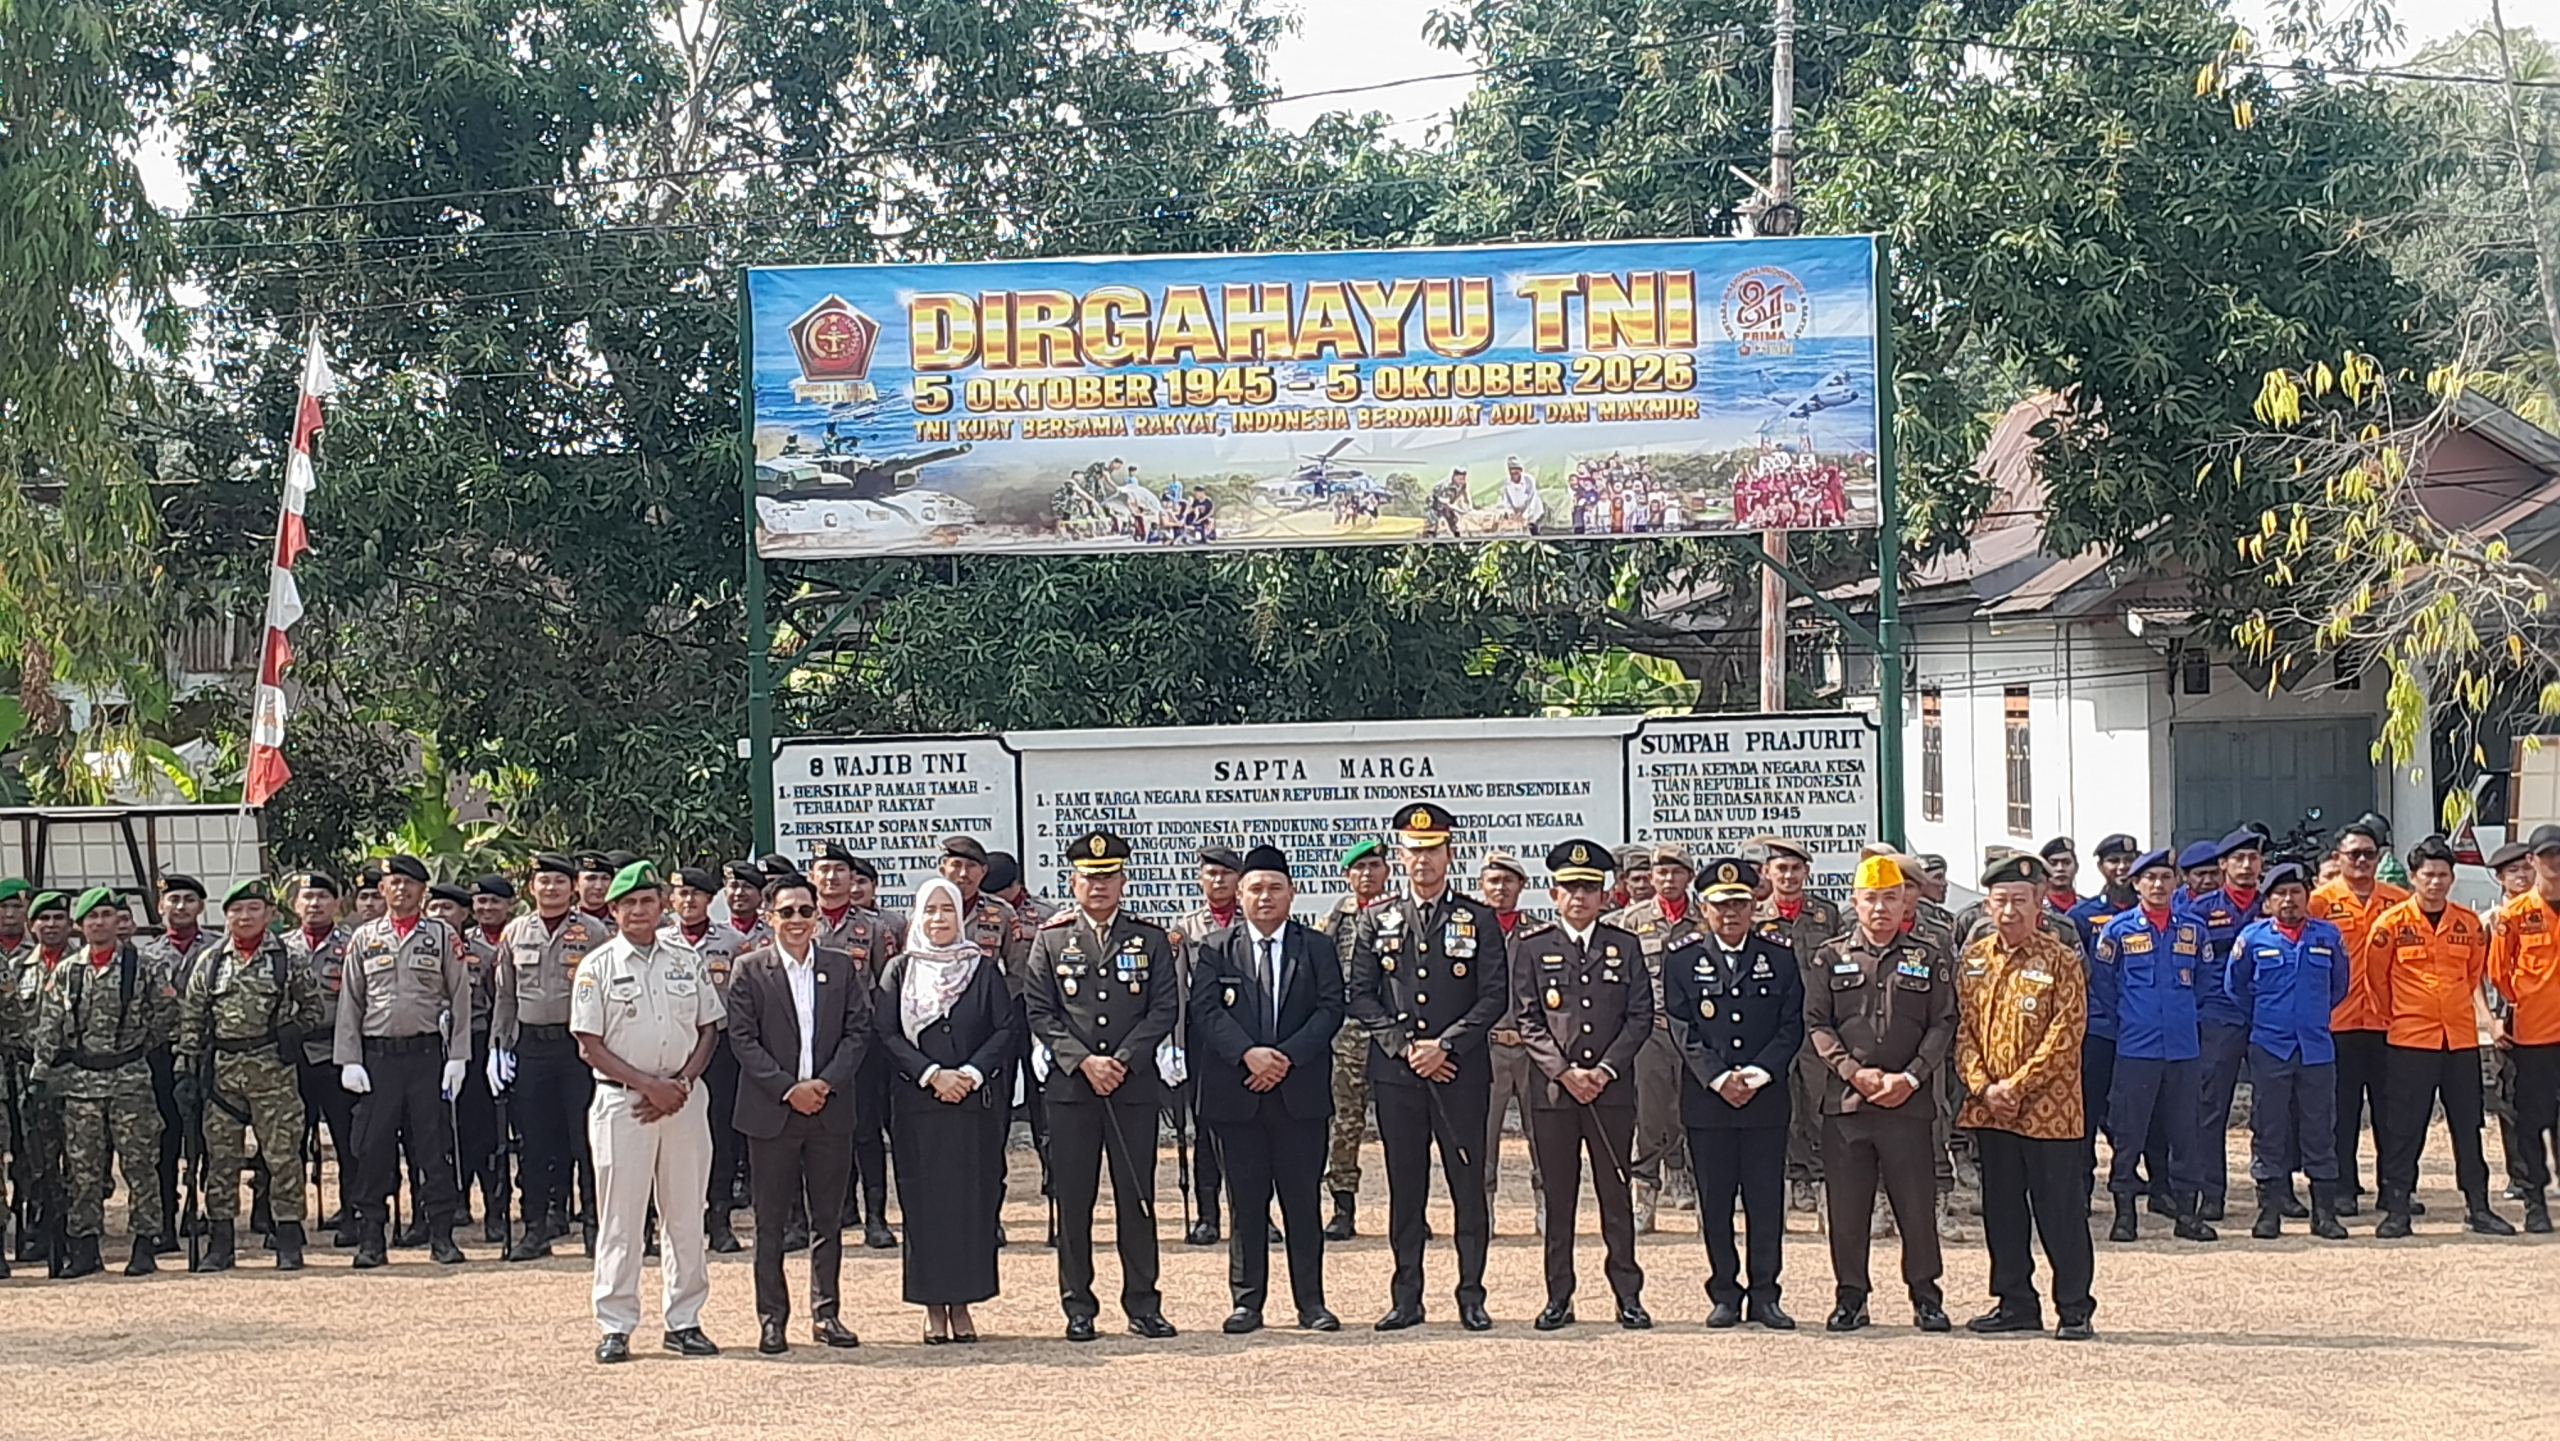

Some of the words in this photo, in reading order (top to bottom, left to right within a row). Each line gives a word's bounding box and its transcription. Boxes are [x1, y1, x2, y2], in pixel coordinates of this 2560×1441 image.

[910, 275, 1494, 370] DIRGAHAYU
[1516, 269, 1698, 353] TNI
[1743, 331, 1786, 341] PRIMA
[912, 375, 953, 415] 5
[965, 373, 1157, 412] OKTOBER
[1163, 366, 1277, 407] 1945
[1325, 363, 1361, 404] 5
[1373, 361, 1566, 401] OKTOBER
[1572, 353, 1698, 394] 2026
[913, 420, 950, 442] TNI
[957, 419, 1013, 441] KUAT
[1022, 416, 1128, 439] BERSAMA
[1134, 412, 1225, 437] RAKYAT,
[1231, 407, 1349, 433] INDONESIA
[1357, 404, 1482, 429] BERDAULAT
[1489, 403, 1538, 425] ADIL
[1545, 401, 1589, 423] DAN
[1597, 398, 1700, 422] MAKMUR
[1641, 732, 1729, 754] SUMPAH
[1746, 729, 1865, 752] PRAJURIT
[810, 758, 824, 776] 8
[834, 755, 912, 776] WAJIB
[922, 753, 967, 774] TNI
[1214, 760, 1307, 781] SAPTA
[1340, 757, 1434, 778] MARGA
[1651, 763, 1698, 777] SETIA
[1702, 762, 1758, 775] KEPADA
[1763, 760, 1821, 775] NEGARA
[1826, 759, 1865, 773] KESA
[793, 784, 872, 798] BERSIKAP
[875, 782, 926, 797] RAMAH
[929, 781, 978, 795] TAMAH
[1652, 779, 1690, 792] TUAN
[1694, 777, 1770, 791] REPUBLIK
[1776, 774, 1862, 789] INDONESIA
[1055, 792, 1091, 806] KAMI
[1095, 791, 1141, 805] WARGA
[1144, 790, 1201, 805] NEGARA
[1206, 788, 1280, 803] KESATUAN
[1283, 786, 1360, 802] REPUBLIK
[1364, 785, 1446, 799] INDONESIA
[1448, 783, 1484, 798] YANG
[1487, 781, 1591, 797] BERSENDIKAN
[1652, 794, 1689, 807] YANG
[1694, 791, 1804, 806] BERDASARKAN
[1808, 790, 1855, 804] PANCA
[793, 800, 873, 815] TERHADAP
[878, 798, 935, 813] RAKYAT
[1055, 807, 1137, 821] PANCASILA
[1653, 809, 1690, 822] SILA
[1694, 808, 1723, 822] DAN
[1727, 807, 1756, 821] UUD
[1762, 806, 1800, 819] 1945
[795, 821, 874, 836] BERSIKAP
[879, 819, 929, 834] SOPAN
[931, 818, 992, 833] SANTUN
[1158, 819, 1239, 834] INDONESIA
[1243, 818, 1329, 833] PENDUKUNG
[1332, 817, 1377, 831] SERTA
[1526, 812, 1584, 827] NEGARA
[1280, 833, 1325, 847] TIDAK
[1653, 827, 1713, 841] TUNDUK
[1782, 825, 1833, 838] HUKUM
[1837, 824, 1866, 838] DAN
[881, 835, 937, 850] RAKYAT
[1039, 854, 1054, 868] 3.
[1039, 886, 1056, 899] 4.
[1131, 900, 1185, 914] BANGSA
